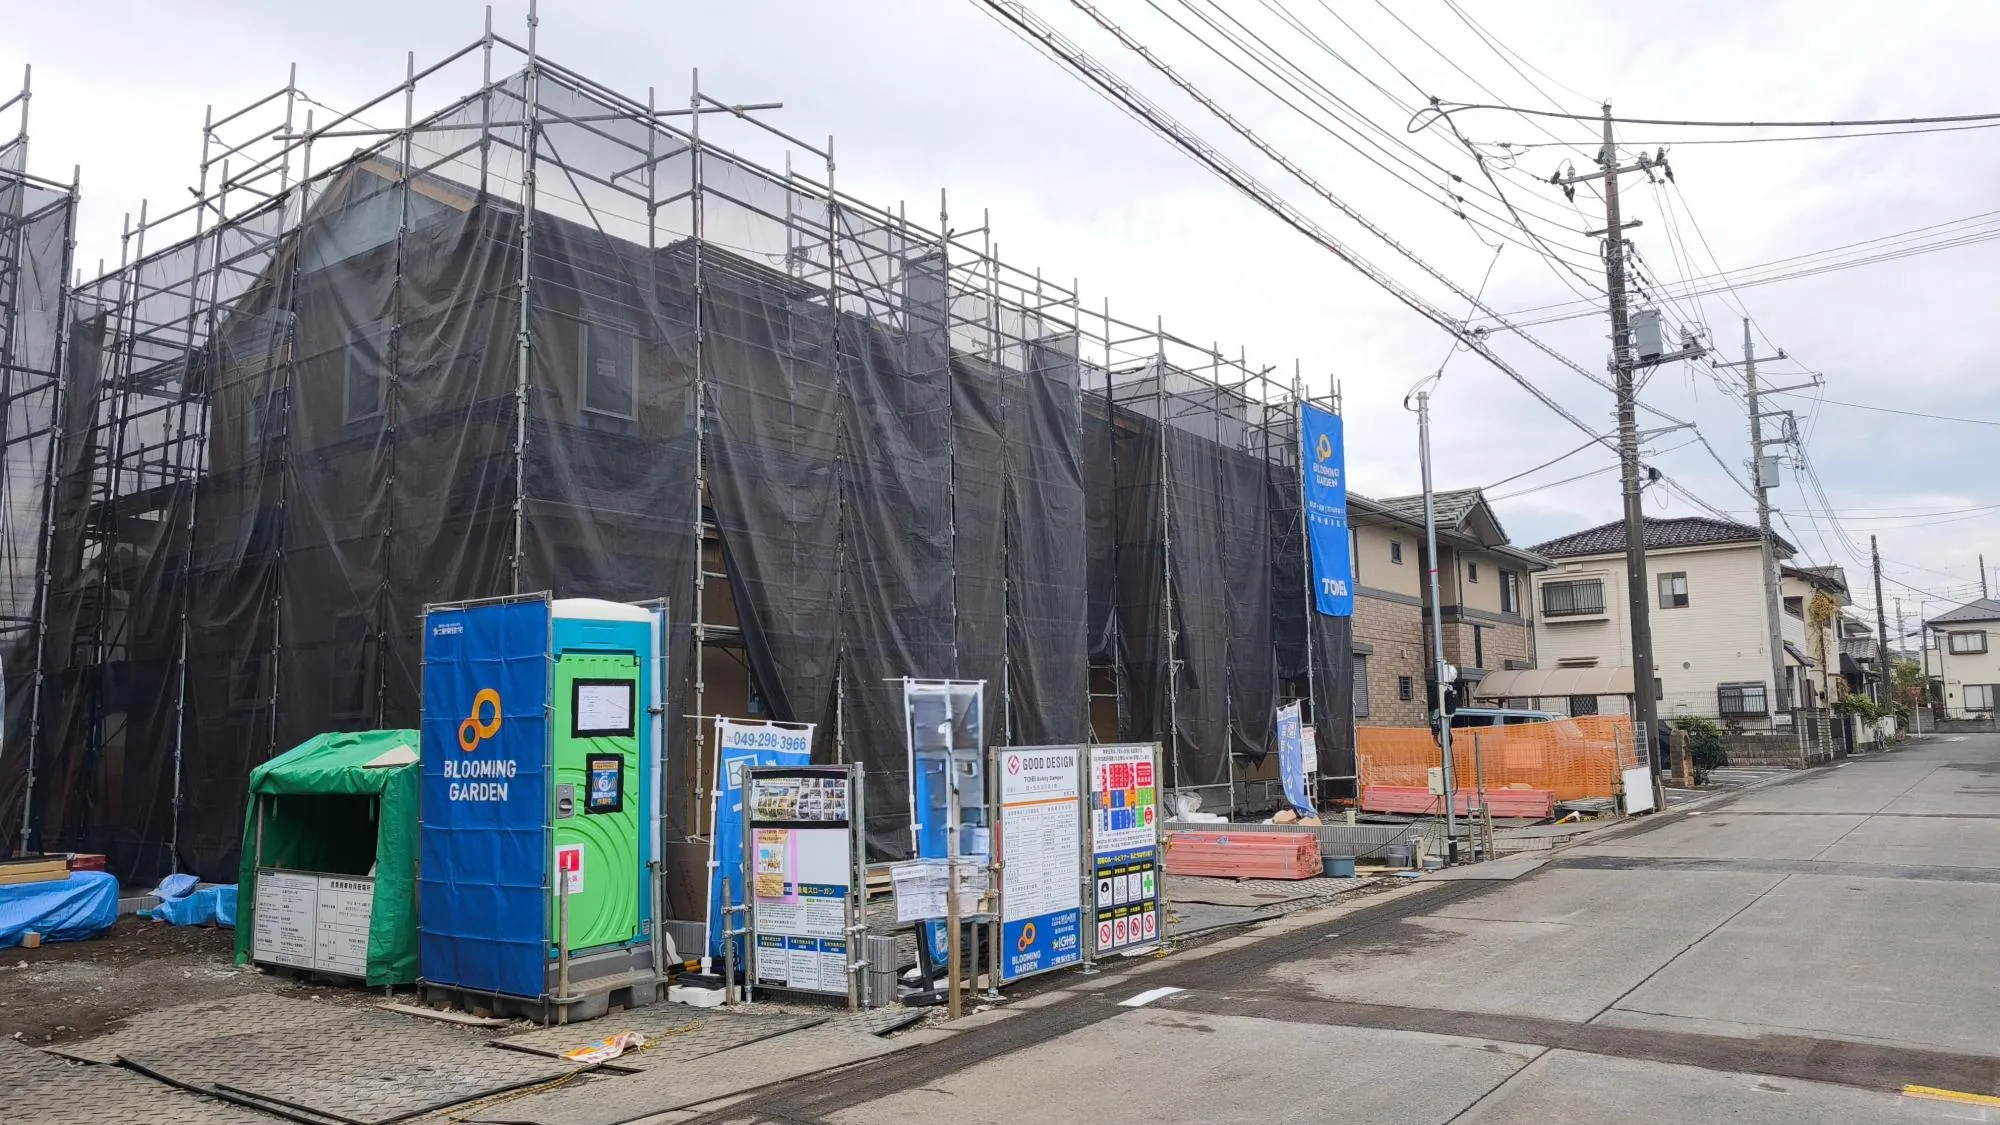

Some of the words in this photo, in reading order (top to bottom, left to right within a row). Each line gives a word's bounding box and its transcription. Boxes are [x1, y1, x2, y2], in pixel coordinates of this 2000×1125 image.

[1312, 462, 1340, 478] BLOOMING
[1316, 474, 1338, 488] GARDEN
[443, 759, 517, 779] BLOOMING
[1022, 757, 1044, 770] GOOD
[1046, 756, 1074, 769] DESIGN
[449, 782, 509, 802] GARDEN
[1012, 950, 1041, 965] BLOOMING
[1015, 960, 1038, 974] GARDEN
